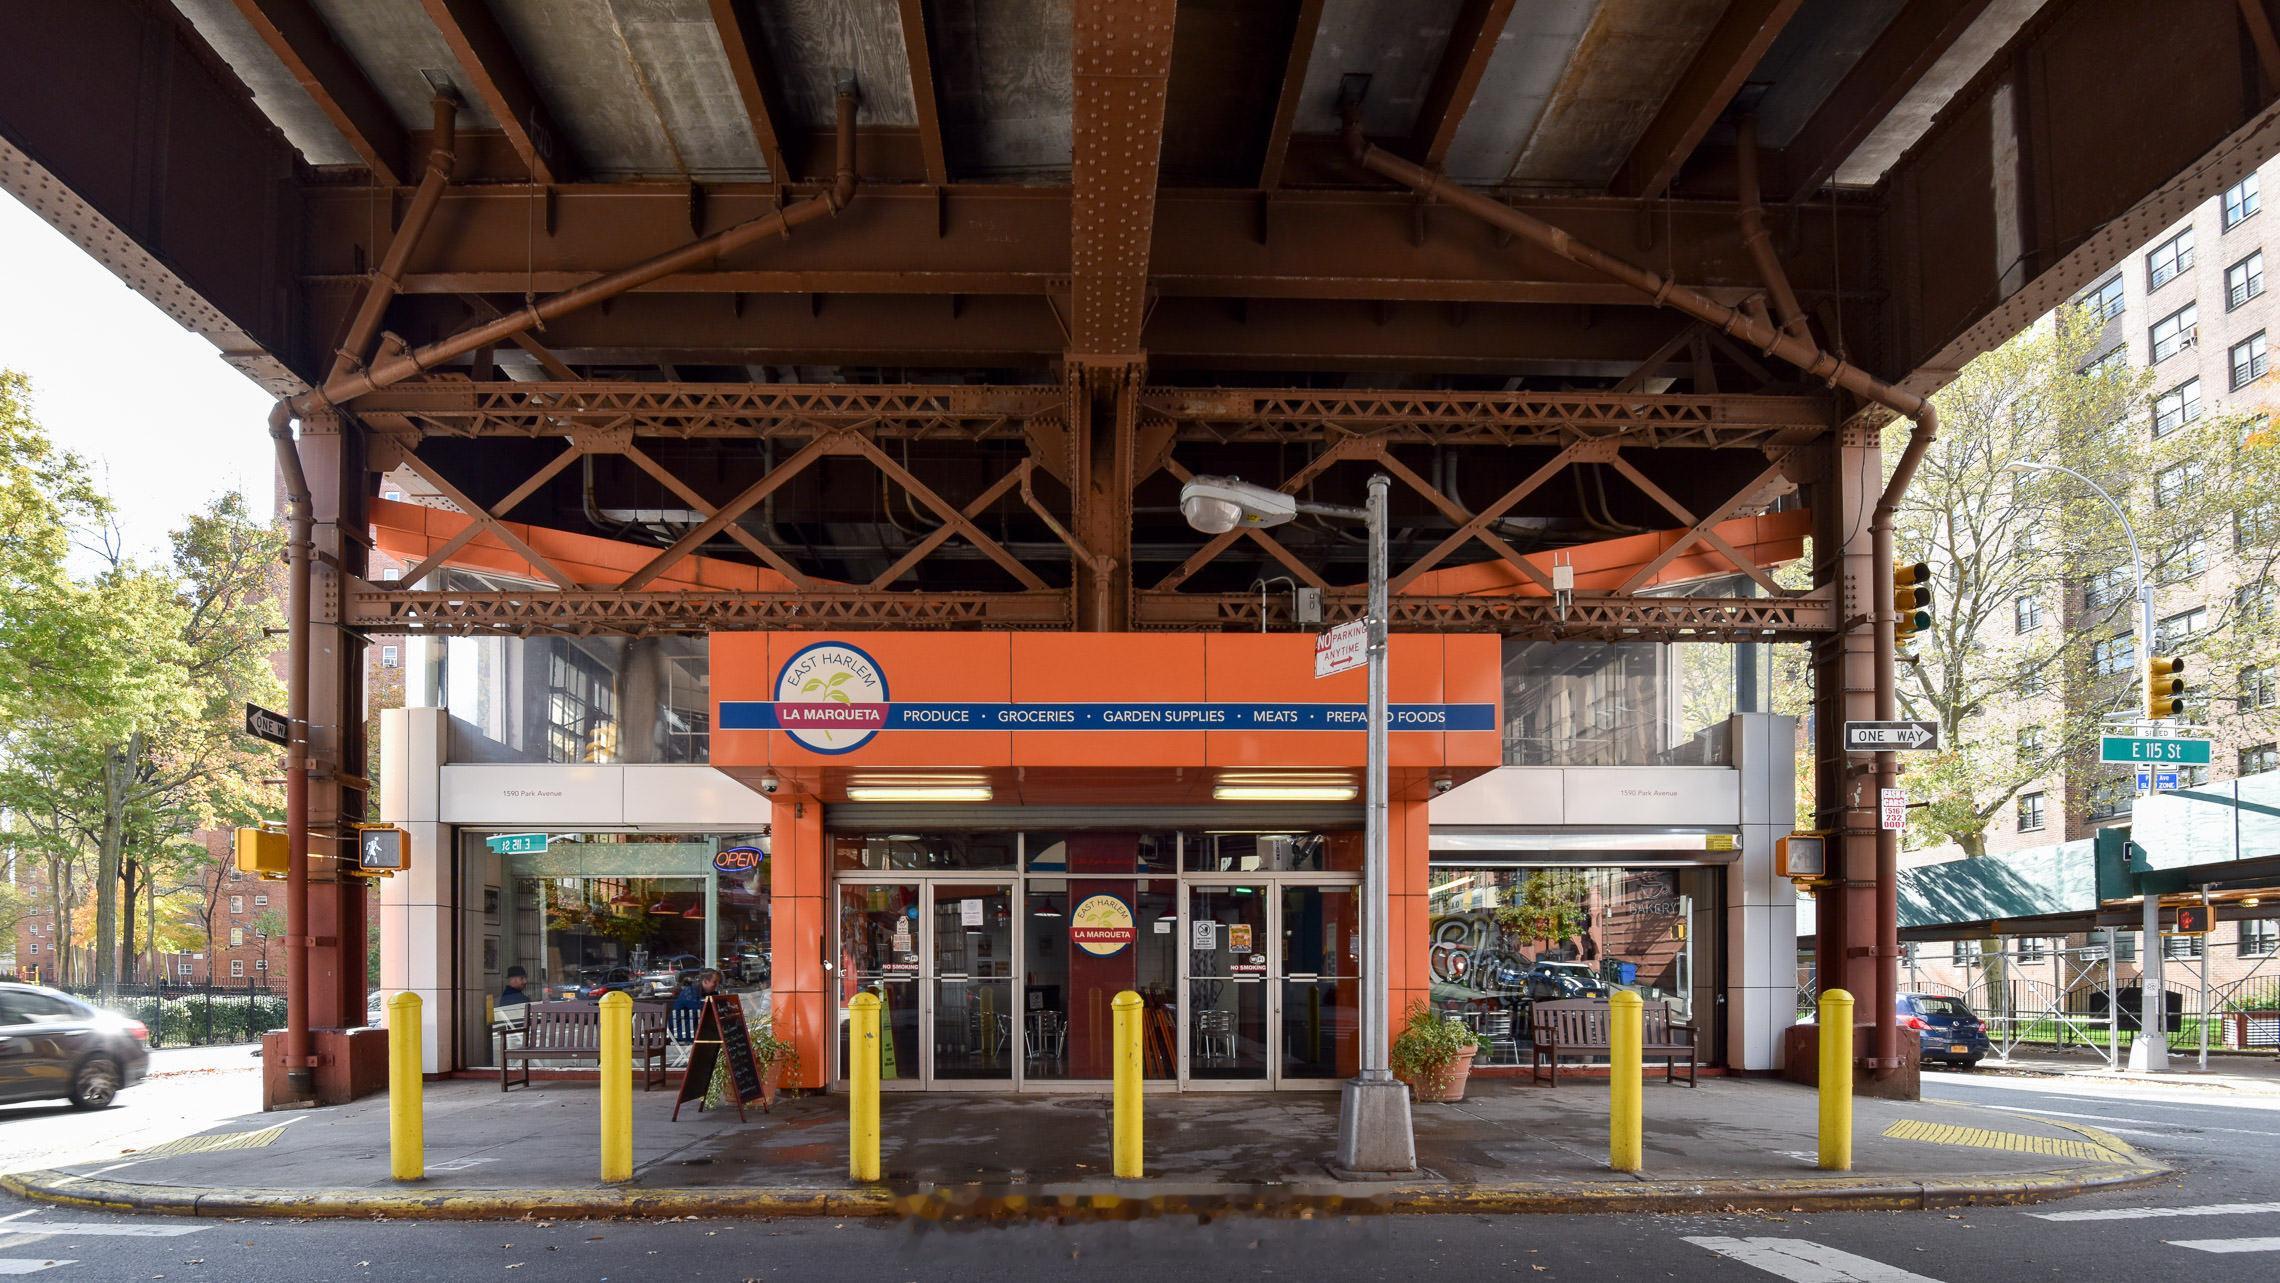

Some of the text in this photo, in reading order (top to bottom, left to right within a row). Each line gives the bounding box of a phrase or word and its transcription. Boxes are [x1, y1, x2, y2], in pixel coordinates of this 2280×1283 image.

[1317, 626, 1367, 651] NO PARKING
[1324, 643, 1359, 661] ANYTIME
[788, 653, 876, 687] EAST HARLEM
[783, 709, 880, 720] LA MARQUETA
[903, 710, 1445, 722] PRODUCE GROCERIES GARDEN SUPPLIES MEATS PREPAD FOODS
[257, 717, 288, 737] ONE WA
[1858, 730, 1924, 742] ONE WAY
[2132, 742, 2182, 759] E 115 St
[1621, 789, 1678, 797] 1590 Park Avenue
[1886, 814, 1903, 822] 232
[716, 851, 760, 867] OPEN
[1077, 899, 1129, 919] EAST HARLEM
[1629, 901, 1678, 915] BAKERY
